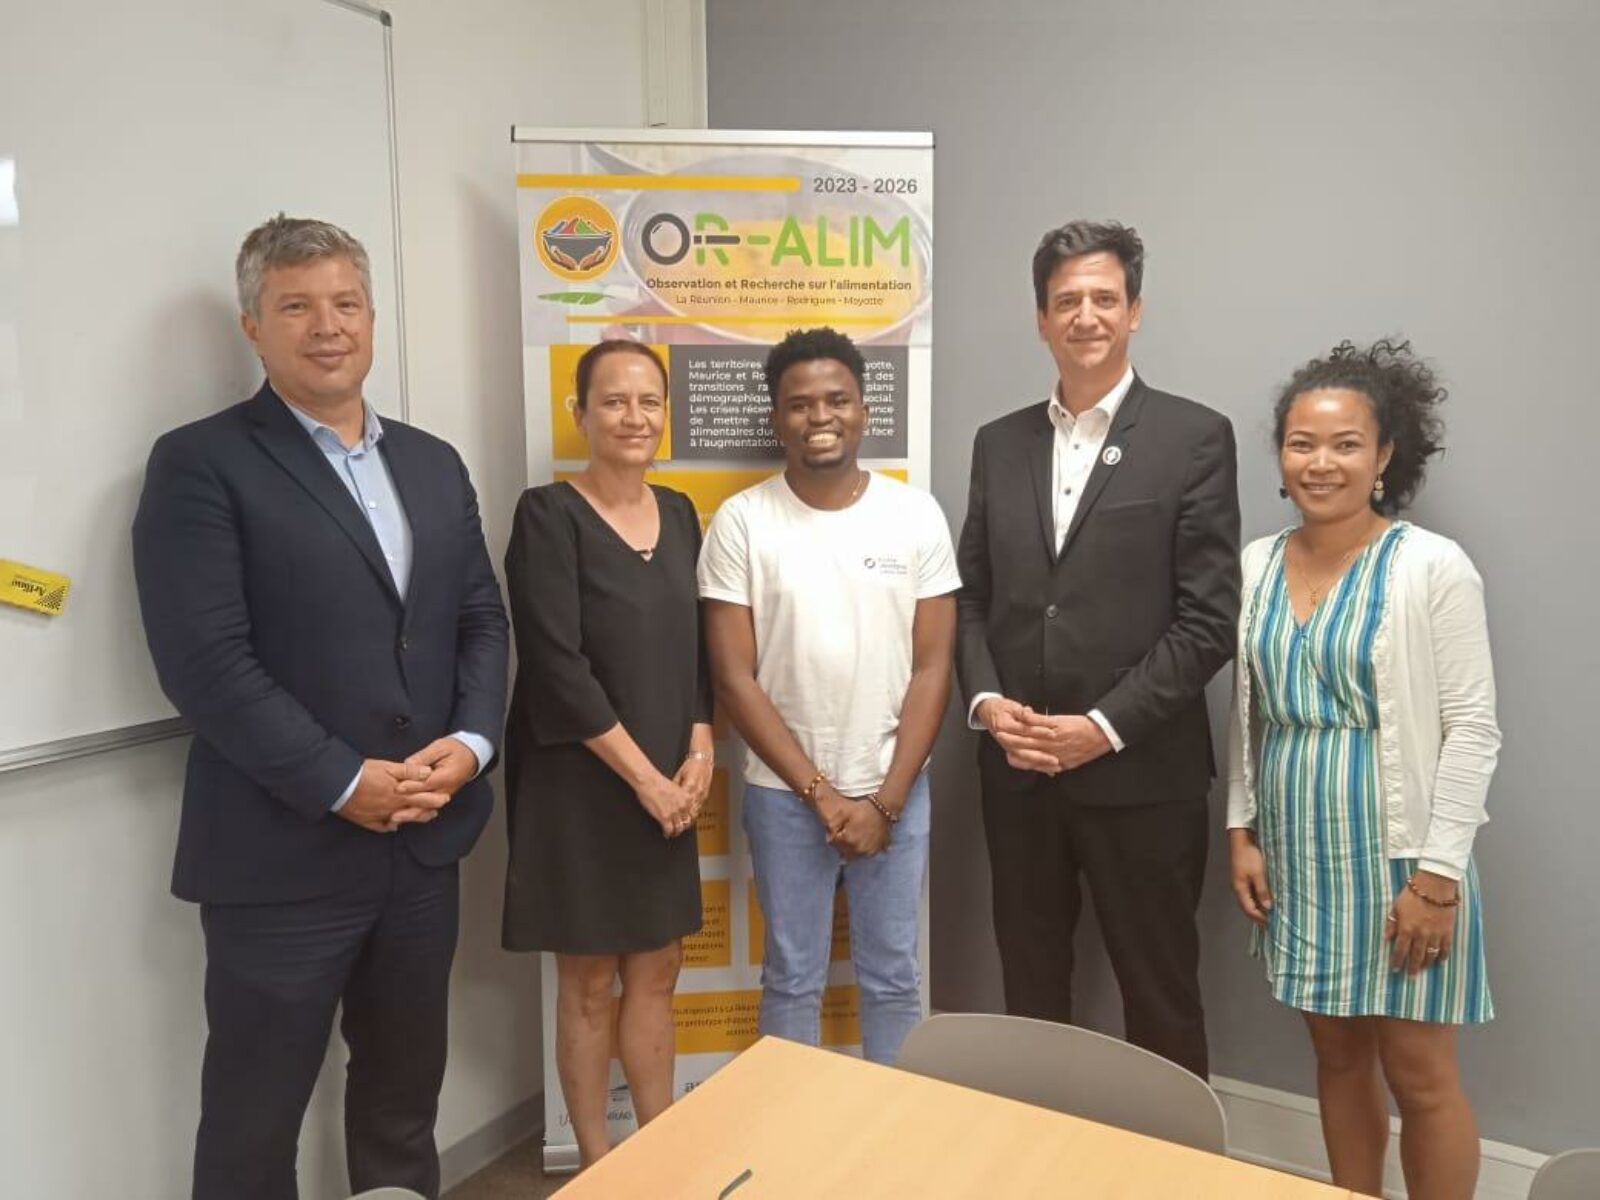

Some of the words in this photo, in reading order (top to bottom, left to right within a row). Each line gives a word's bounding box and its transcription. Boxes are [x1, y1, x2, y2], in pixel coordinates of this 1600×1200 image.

[813, 177, 857, 193] 2023
[874, 178, 918, 194] 2026
[647, 278, 720, 289] Observation
[724, 279, 738, 289] et
[741, 278, 805, 290] Recherche
[808, 281, 827, 290] sur
[830, 279, 912, 290] l'alimentation
[676, 295, 687, 304] La
[688, 360, 707, 369] Les
[710, 359, 762, 369] territoires
[864, 361, 895, 371] yotte,
[688, 371, 732, 380] Maurice
[736, 371, 747, 380] et
[874, 371, 895, 381] des
[688, 382, 745, 392] transitions
[688, 393, 772, 405] démographiqu
[690, 404, 707, 414] Les
[710, 404, 740, 414] crises
[689, 416, 704, 425] de
[713, 416, 750, 425] mettre
[690, 426, 755, 436] alimentaires
[690, 438, 696, 447] à
[699, 437, 778, 450] l'augmentation
